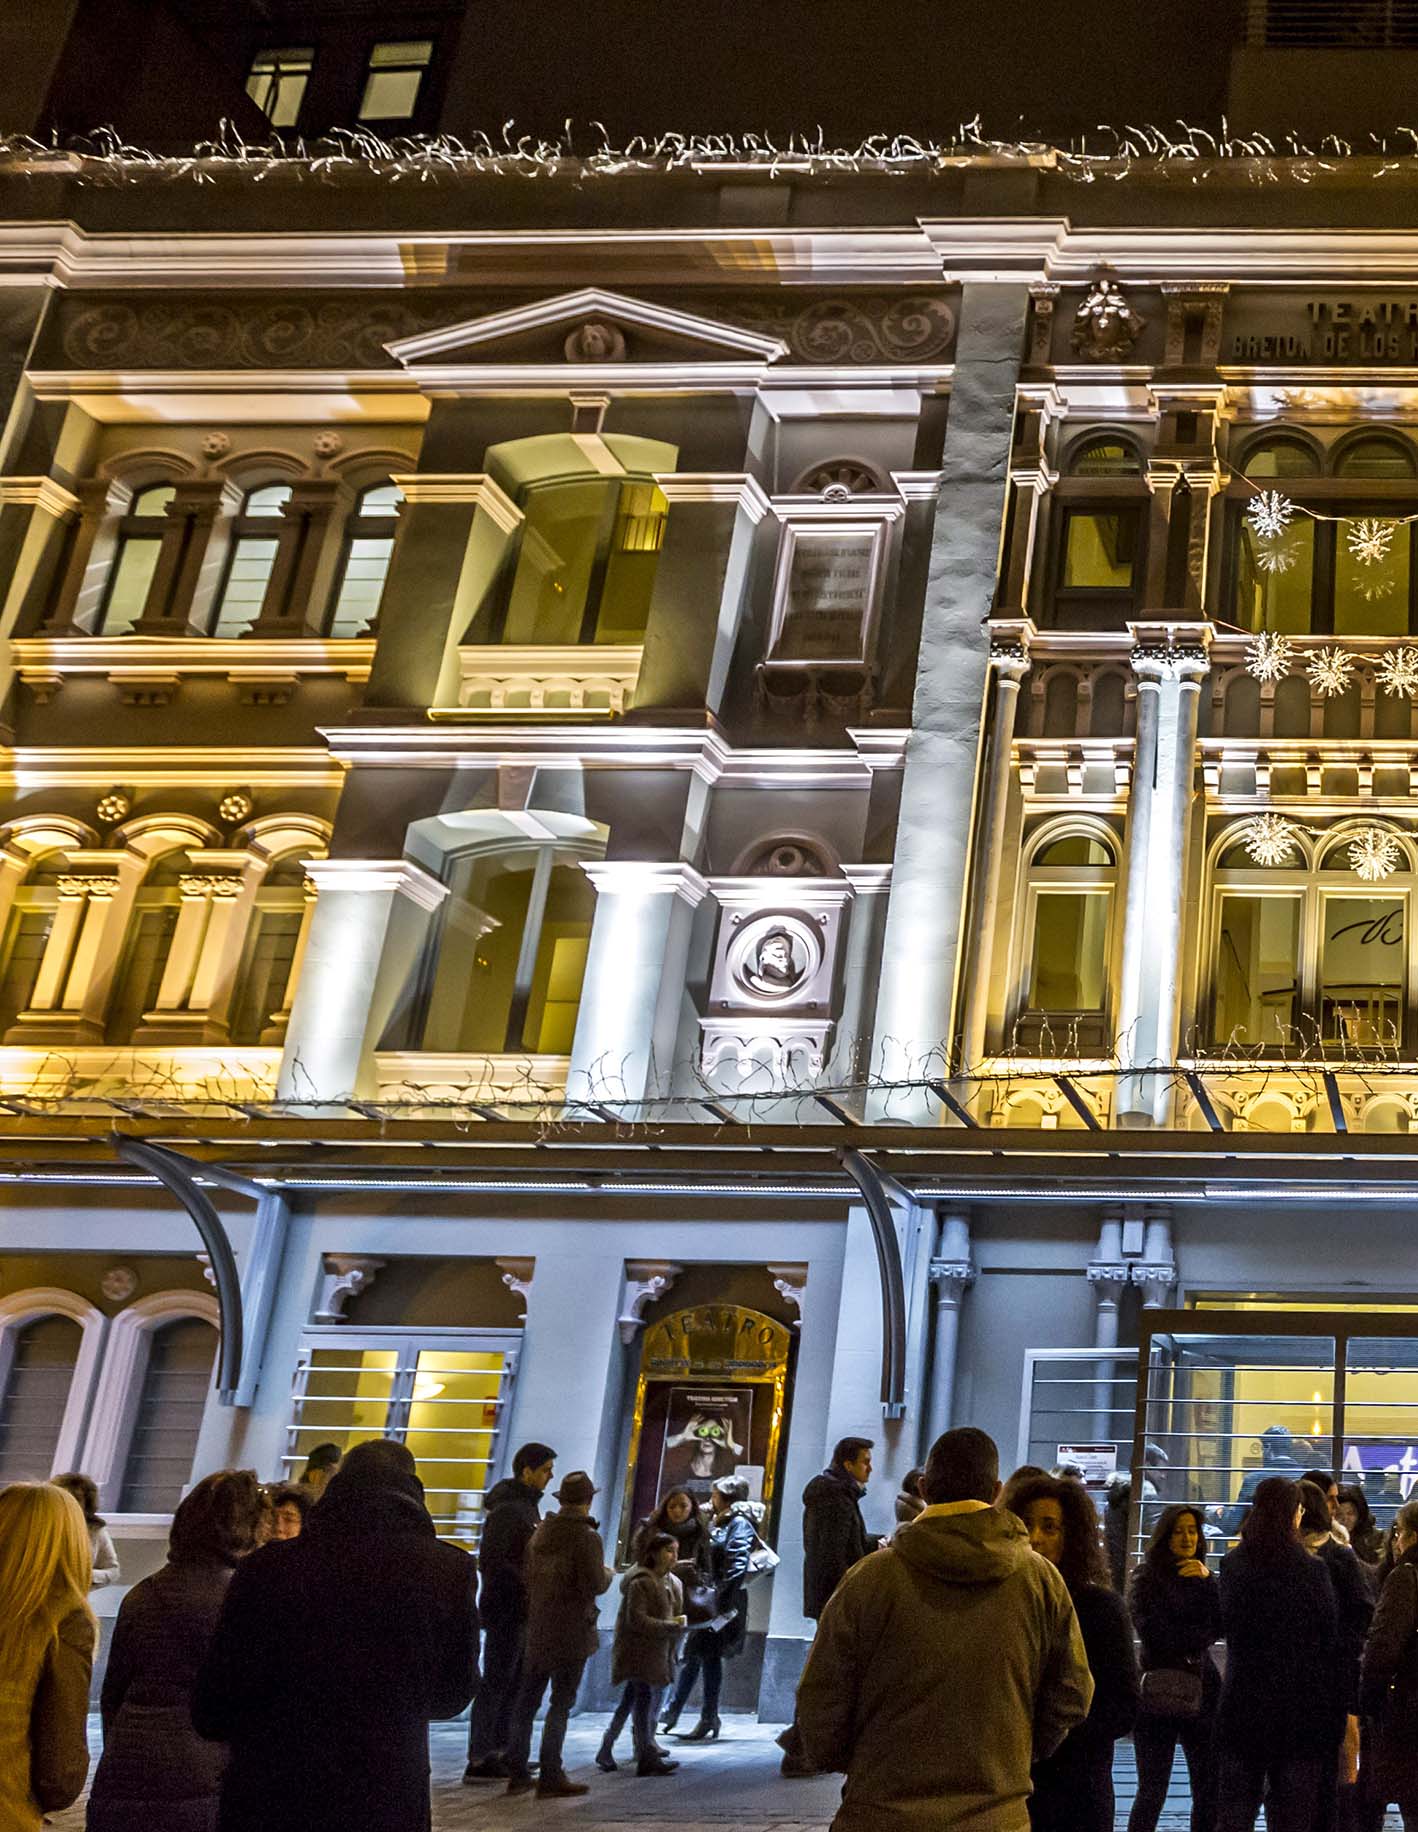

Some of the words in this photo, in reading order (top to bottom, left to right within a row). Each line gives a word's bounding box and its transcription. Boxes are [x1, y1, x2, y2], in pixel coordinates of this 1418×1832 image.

[1323, 333, 1351, 359] DE
[1360, 333, 1400, 360] LOS
[660, 1311, 775, 1344] TEATRO
